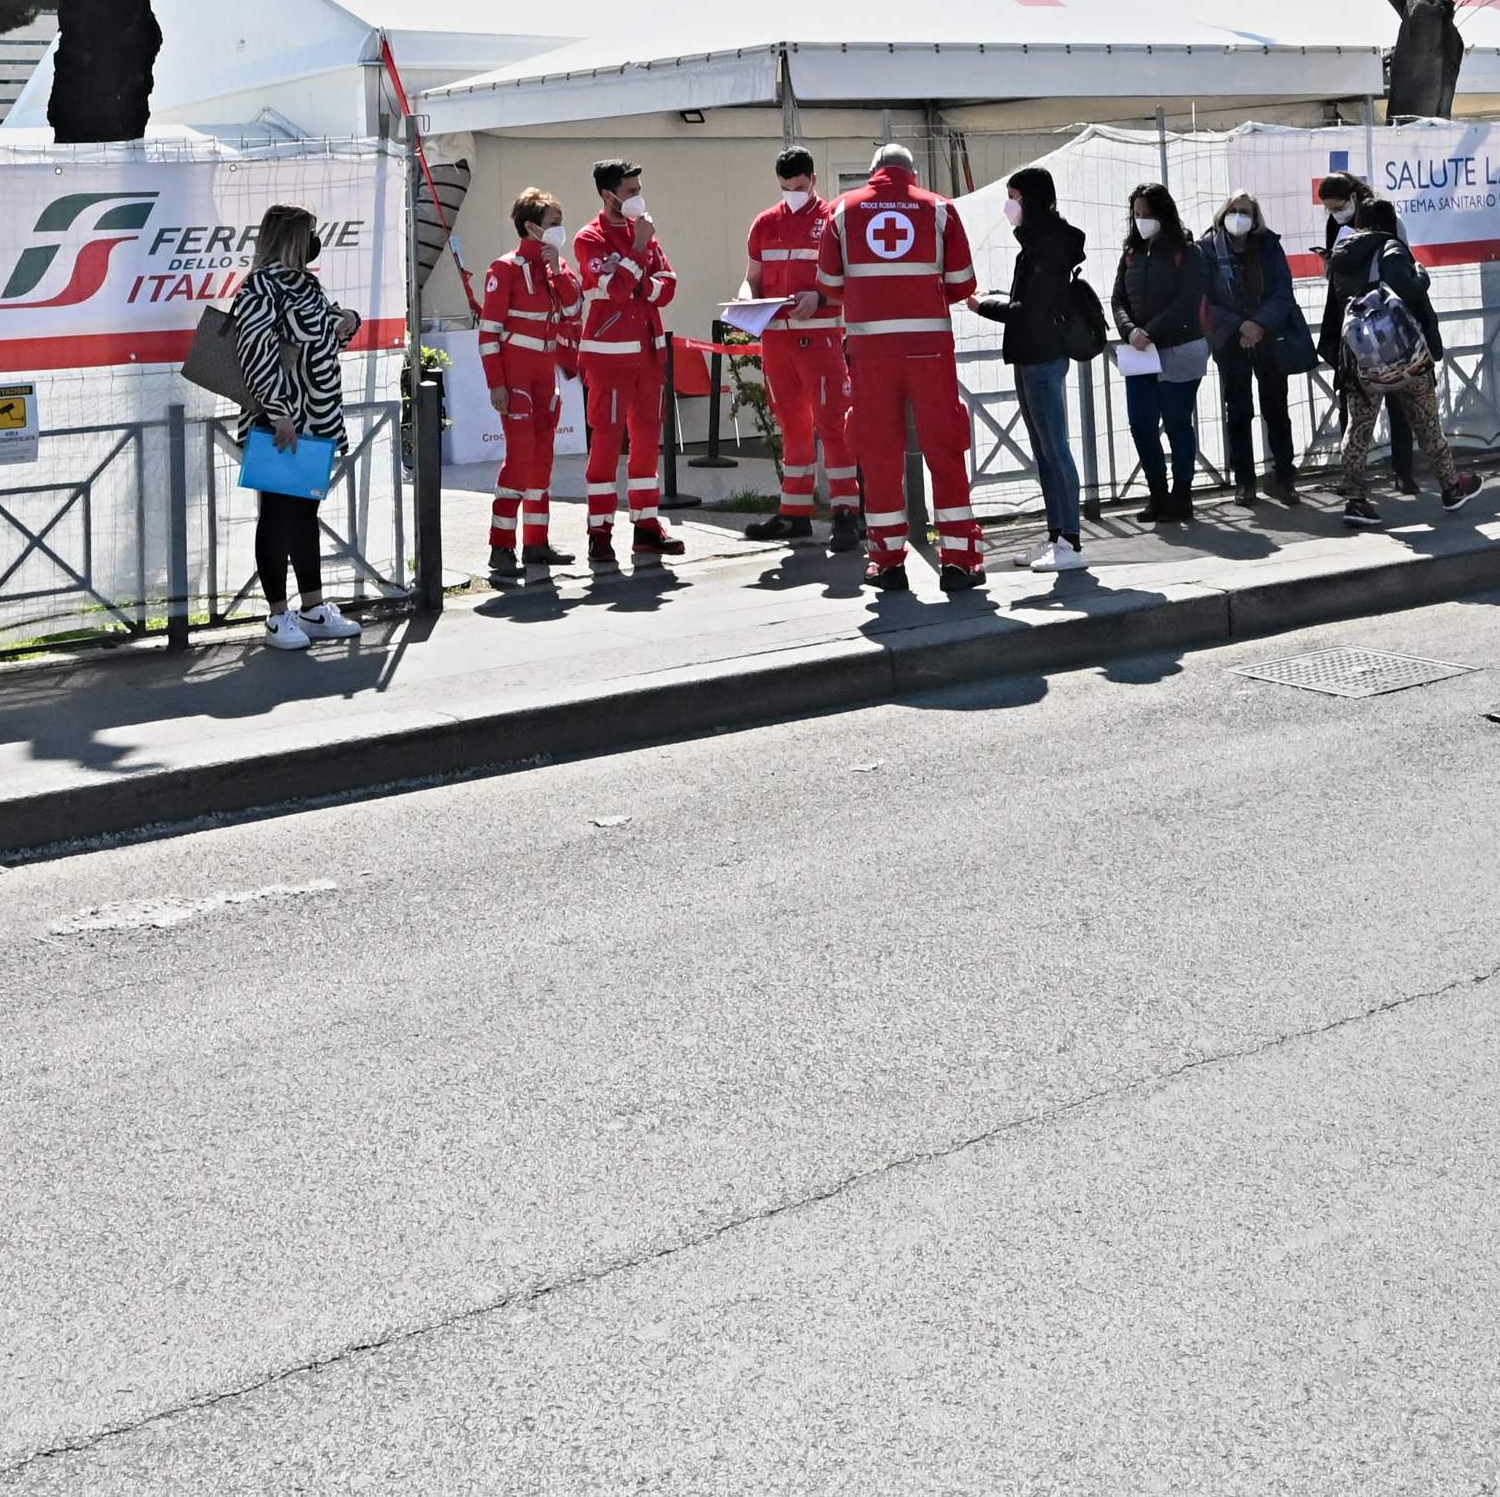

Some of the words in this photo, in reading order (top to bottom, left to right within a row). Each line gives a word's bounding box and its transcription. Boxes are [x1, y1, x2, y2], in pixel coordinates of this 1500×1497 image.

[1385, 158, 1477, 191] SALUTE
[1438, 193, 1496, 211] SANITARIO
[168, 256, 233, 271] DELLO
